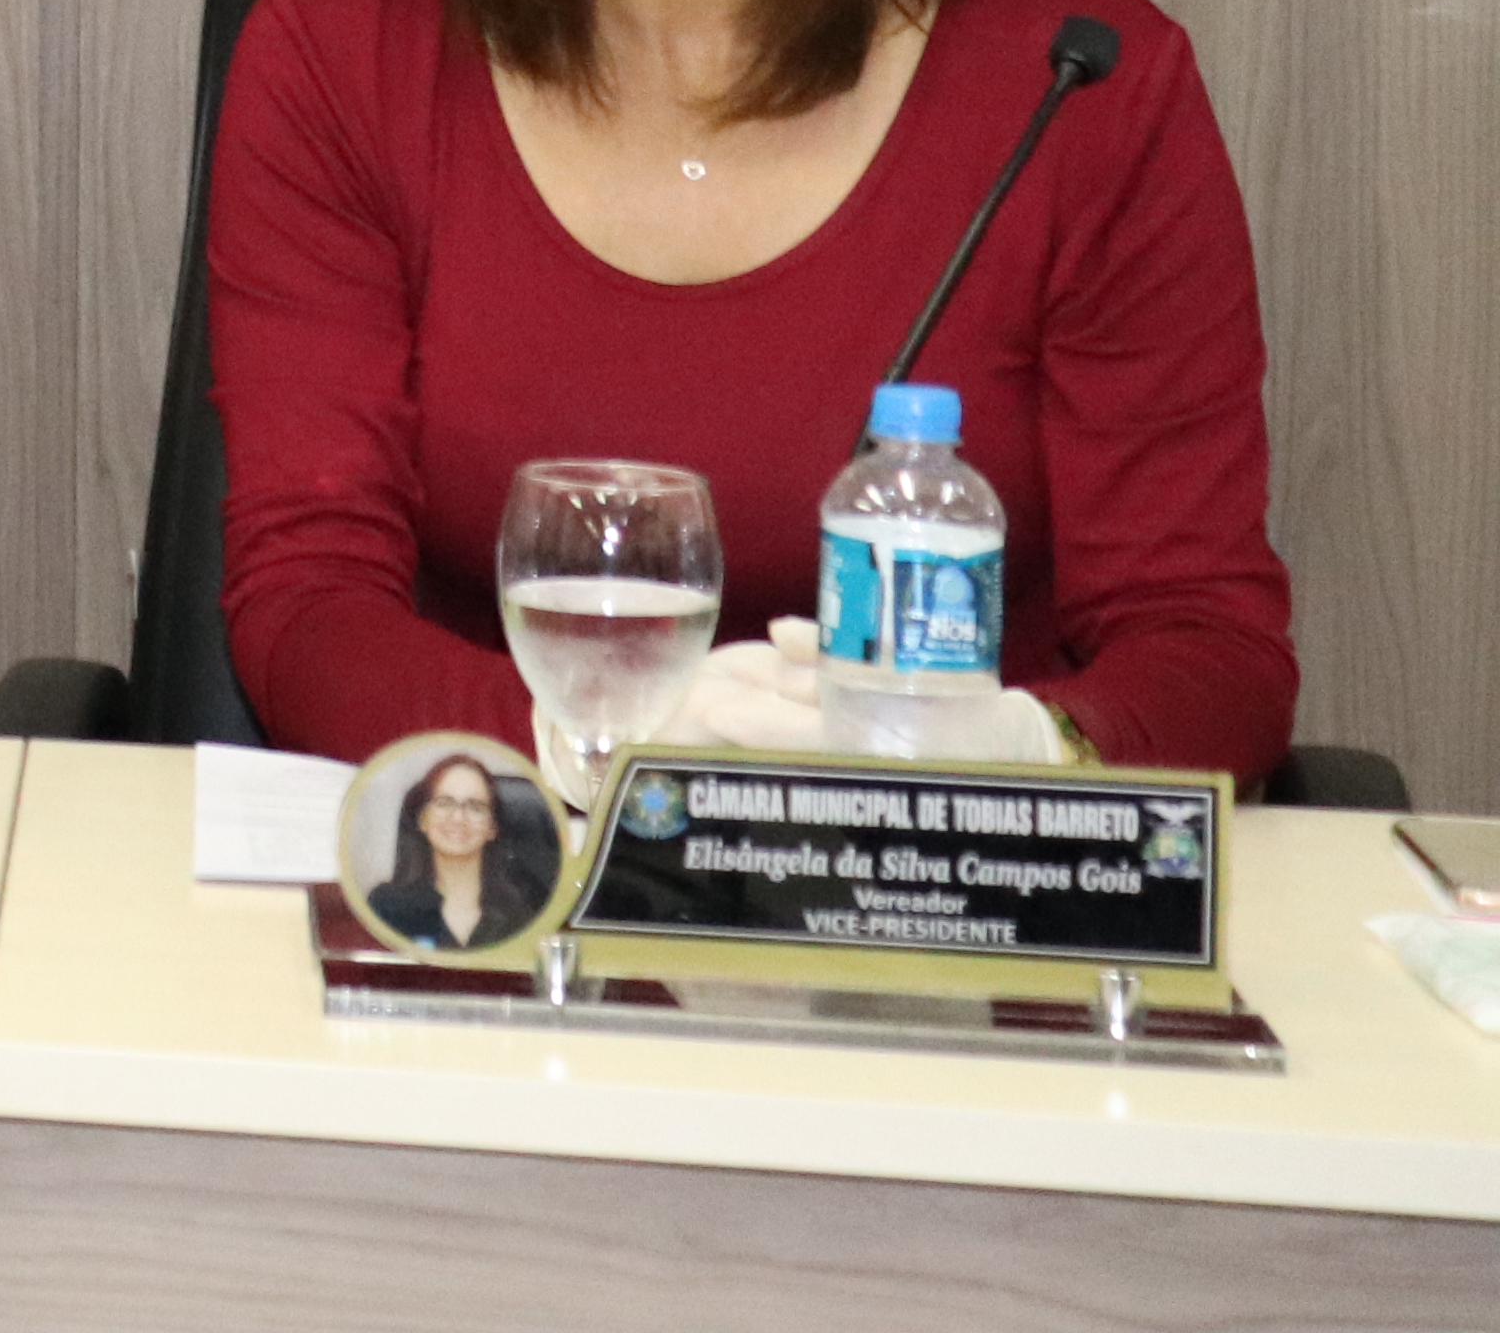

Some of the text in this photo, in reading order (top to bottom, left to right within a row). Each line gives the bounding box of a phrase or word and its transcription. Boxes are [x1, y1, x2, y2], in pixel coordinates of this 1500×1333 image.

[688, 778, 1140, 842] CÂMARA MUNICIPAL DE TOBIAS BARRETO
[684, 836, 1142, 895] Elisângela da Silva Campos Gois
[852, 886, 968, 915] Vereador
[804, 909, 1018, 945] VICE-PRESIDENTE
